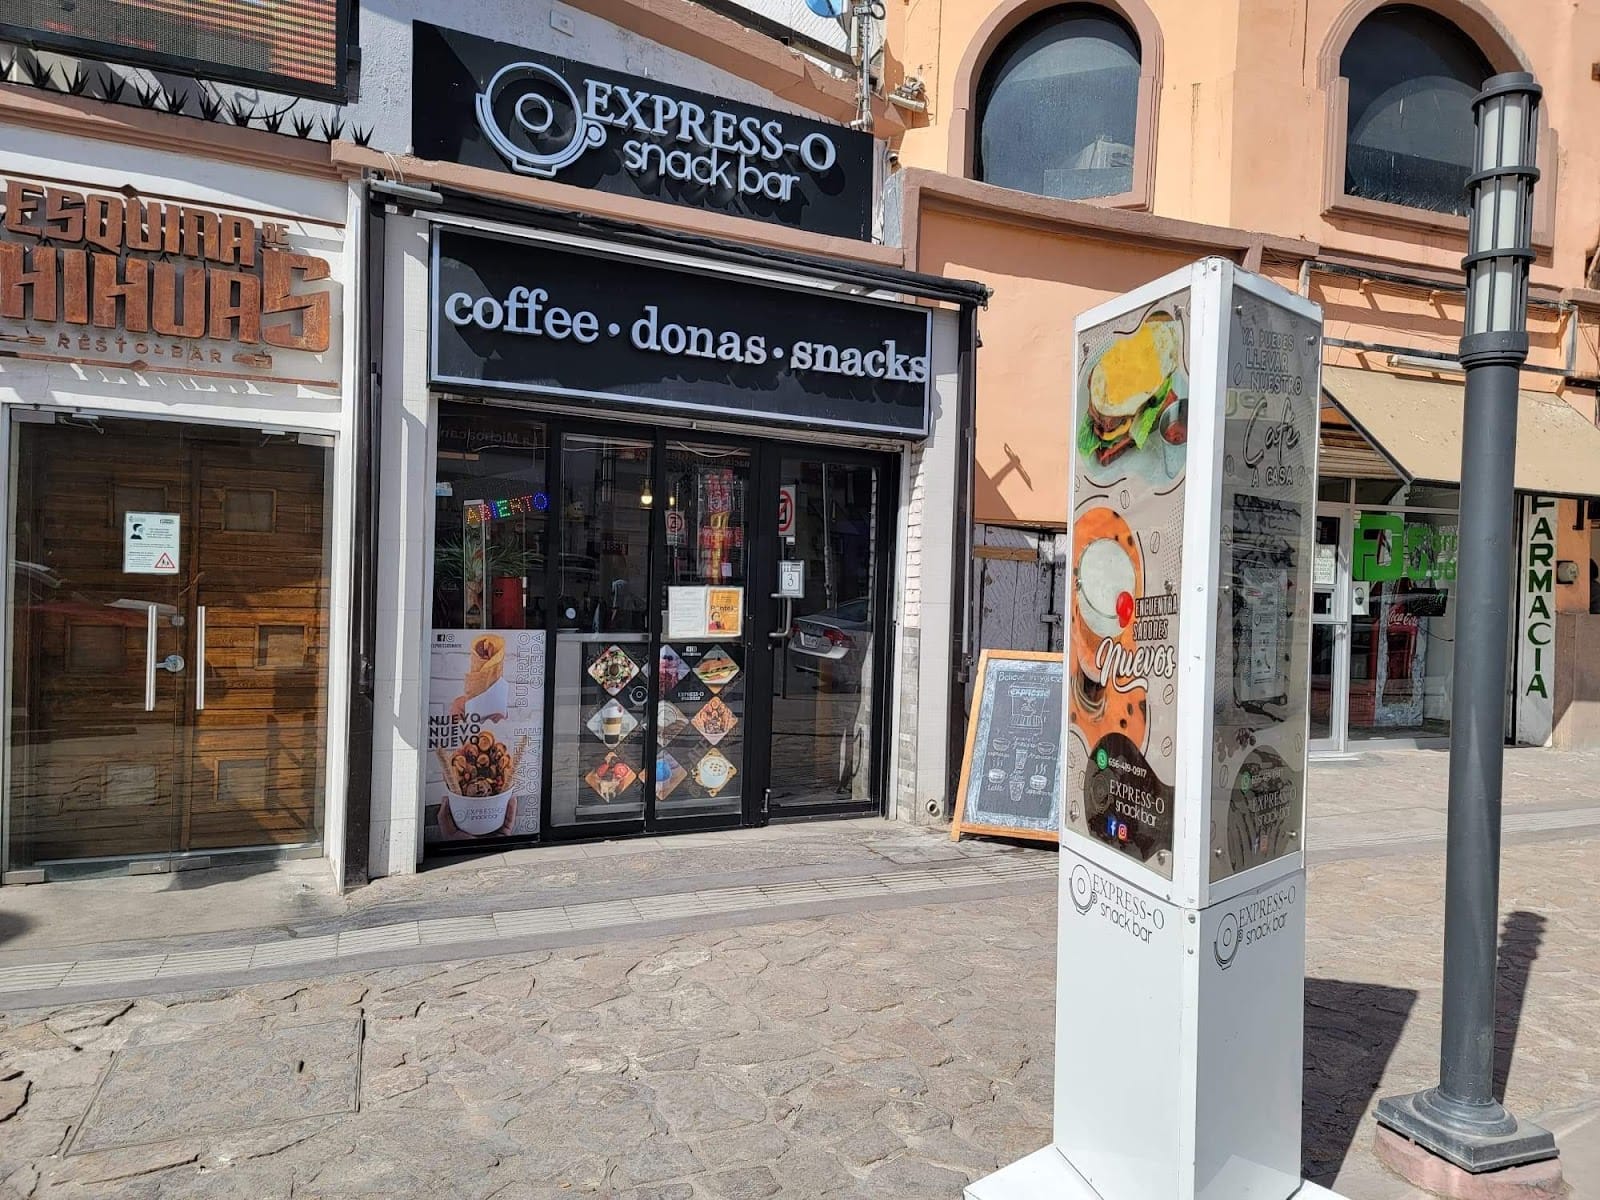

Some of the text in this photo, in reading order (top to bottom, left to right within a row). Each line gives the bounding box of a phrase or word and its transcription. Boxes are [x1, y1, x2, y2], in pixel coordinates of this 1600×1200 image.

[583, 79, 836, 172] EXPRESS-O
[623, 139, 800, 201] snack bar
[5, 180, 291, 267] ESQUINA DE
[444, 285, 928, 384] coffee donas snacks
[1241, 326, 1294, 353] YA PUEDES
[1245, 347, 1289, 374] LLEVAR
[1250, 371, 1302, 396] NUESTRO
[1242, 397, 1300, 468] Café
[1251, 465, 1294, 487] A CASA
[466, 492, 549, 525] ABIERTO
[787, 573, 794, 587] 3
[1526, 495, 1555, 699] FARMACIA
[1134, 594, 1178, 618] ENCUENTRA
[1132, 619, 1169, 642] SABORES
[515, 632, 530, 708] BURRITO
[529, 632, 545, 690] CREPA
[1095, 636, 1177, 694] Nuevos
[429, 713, 481, 726] NUEVO
[429, 724, 481, 737] NUEVO
[428, 735, 480, 749] NUEVO
[525, 727, 542, 833] CHOCOLATE
[1109, 779, 1165, 814] EXPRESS-O
[1115, 799, 1157, 827] snack bar
[1092, 873, 1164, 930] EXPRESS-O
[1239, 885, 1296, 929] EXPRESS-O
[1100, 902, 1153, 944] snack bar
[1246, 912, 1288, 946] snack bar
